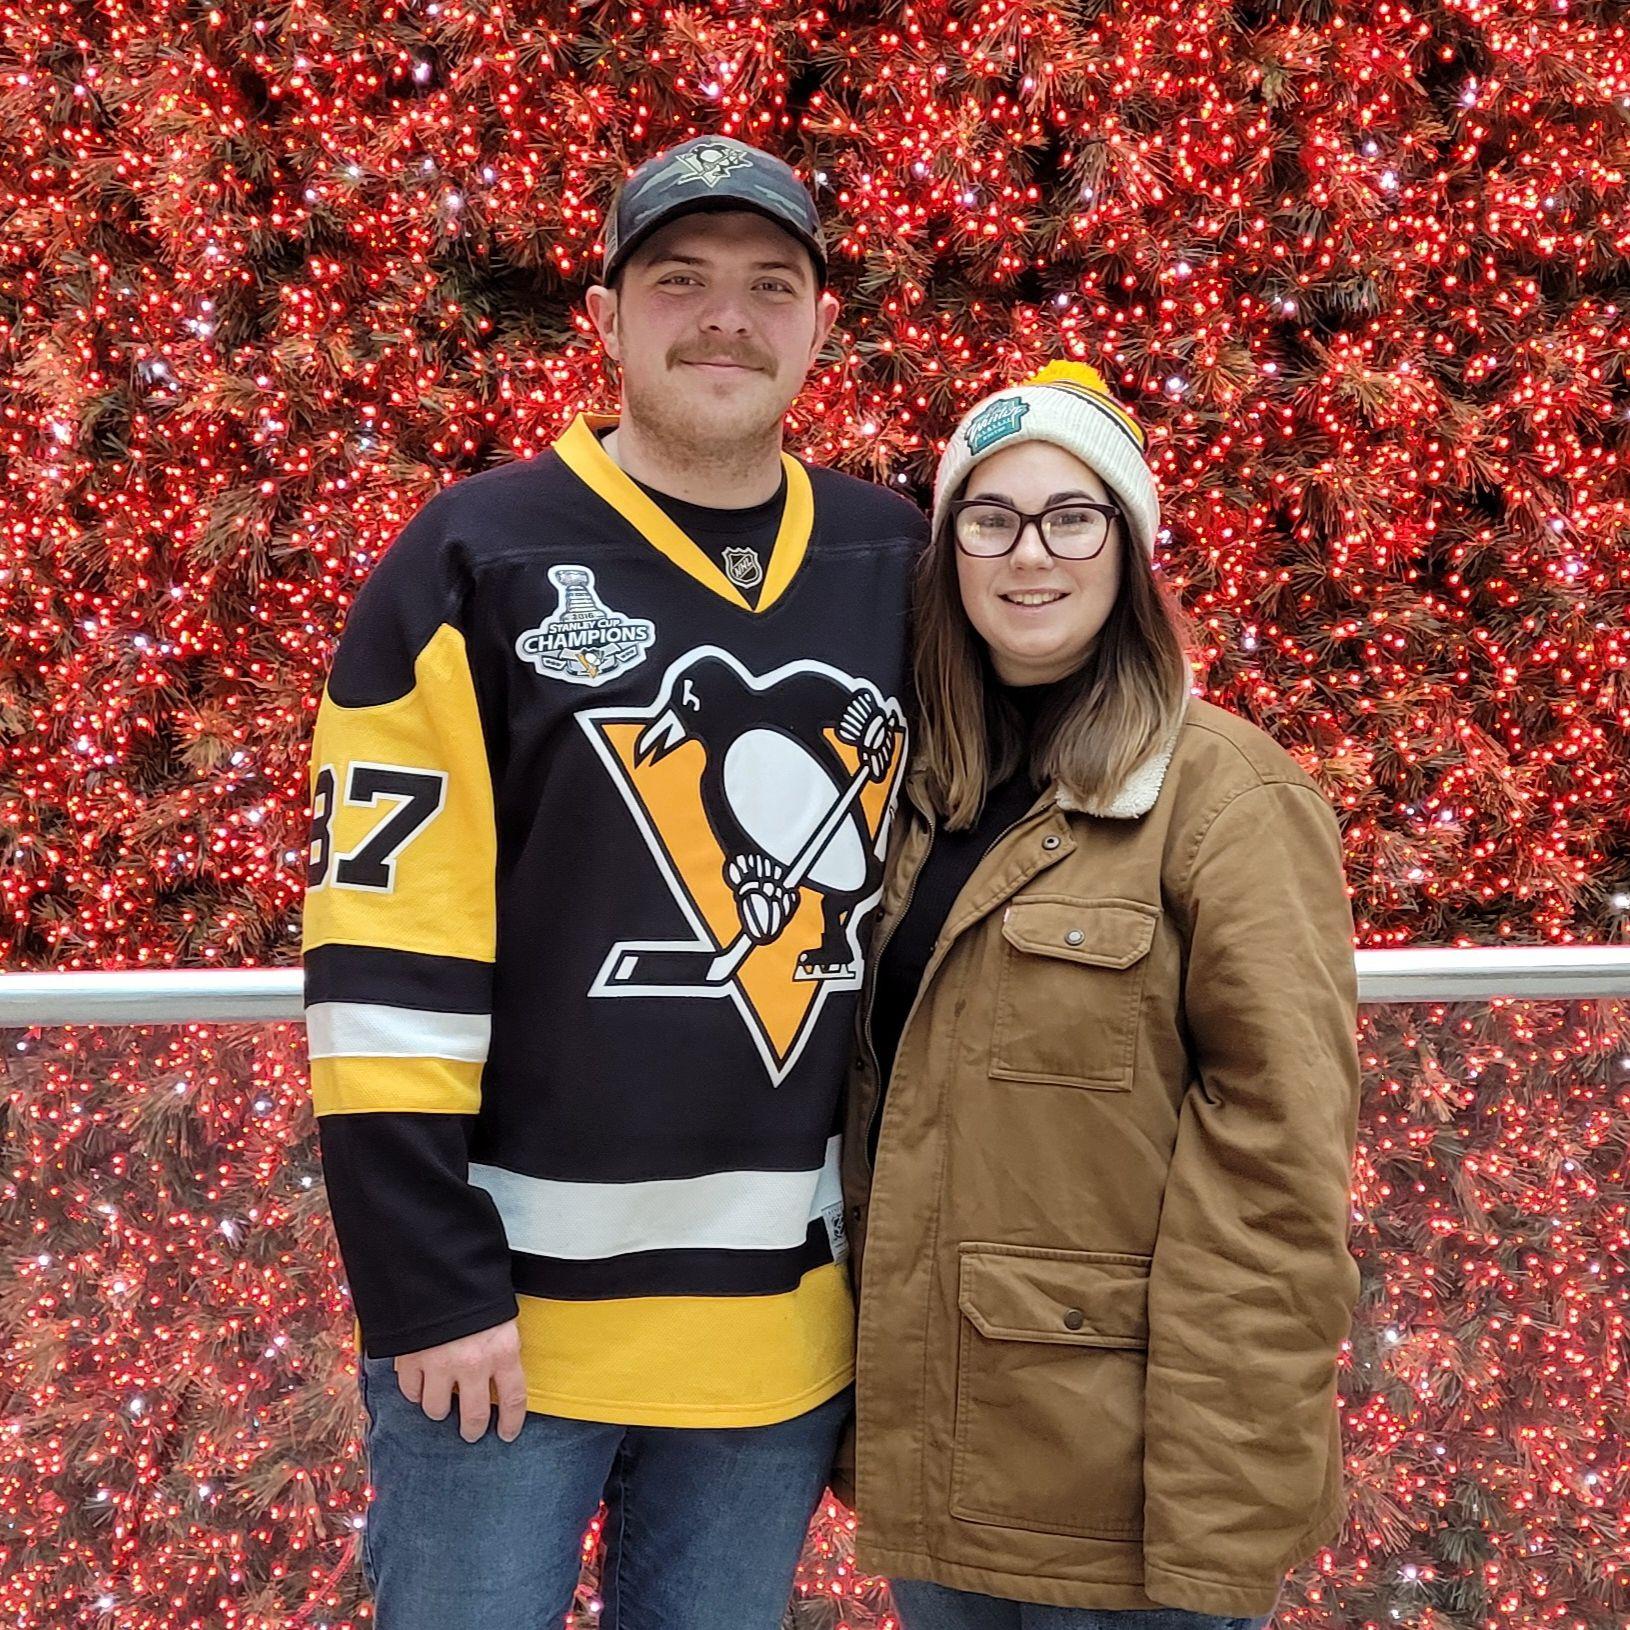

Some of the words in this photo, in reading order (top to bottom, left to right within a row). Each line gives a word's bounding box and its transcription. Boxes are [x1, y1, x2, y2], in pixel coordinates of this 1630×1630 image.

[734, 557, 753, 577] NHL
[572, 612, 595, 621] 2016
[549, 621, 596, 633] STANLEY
[597, 618, 621, 629] CUP
[523, 625, 648, 654] CHAMPIONS
